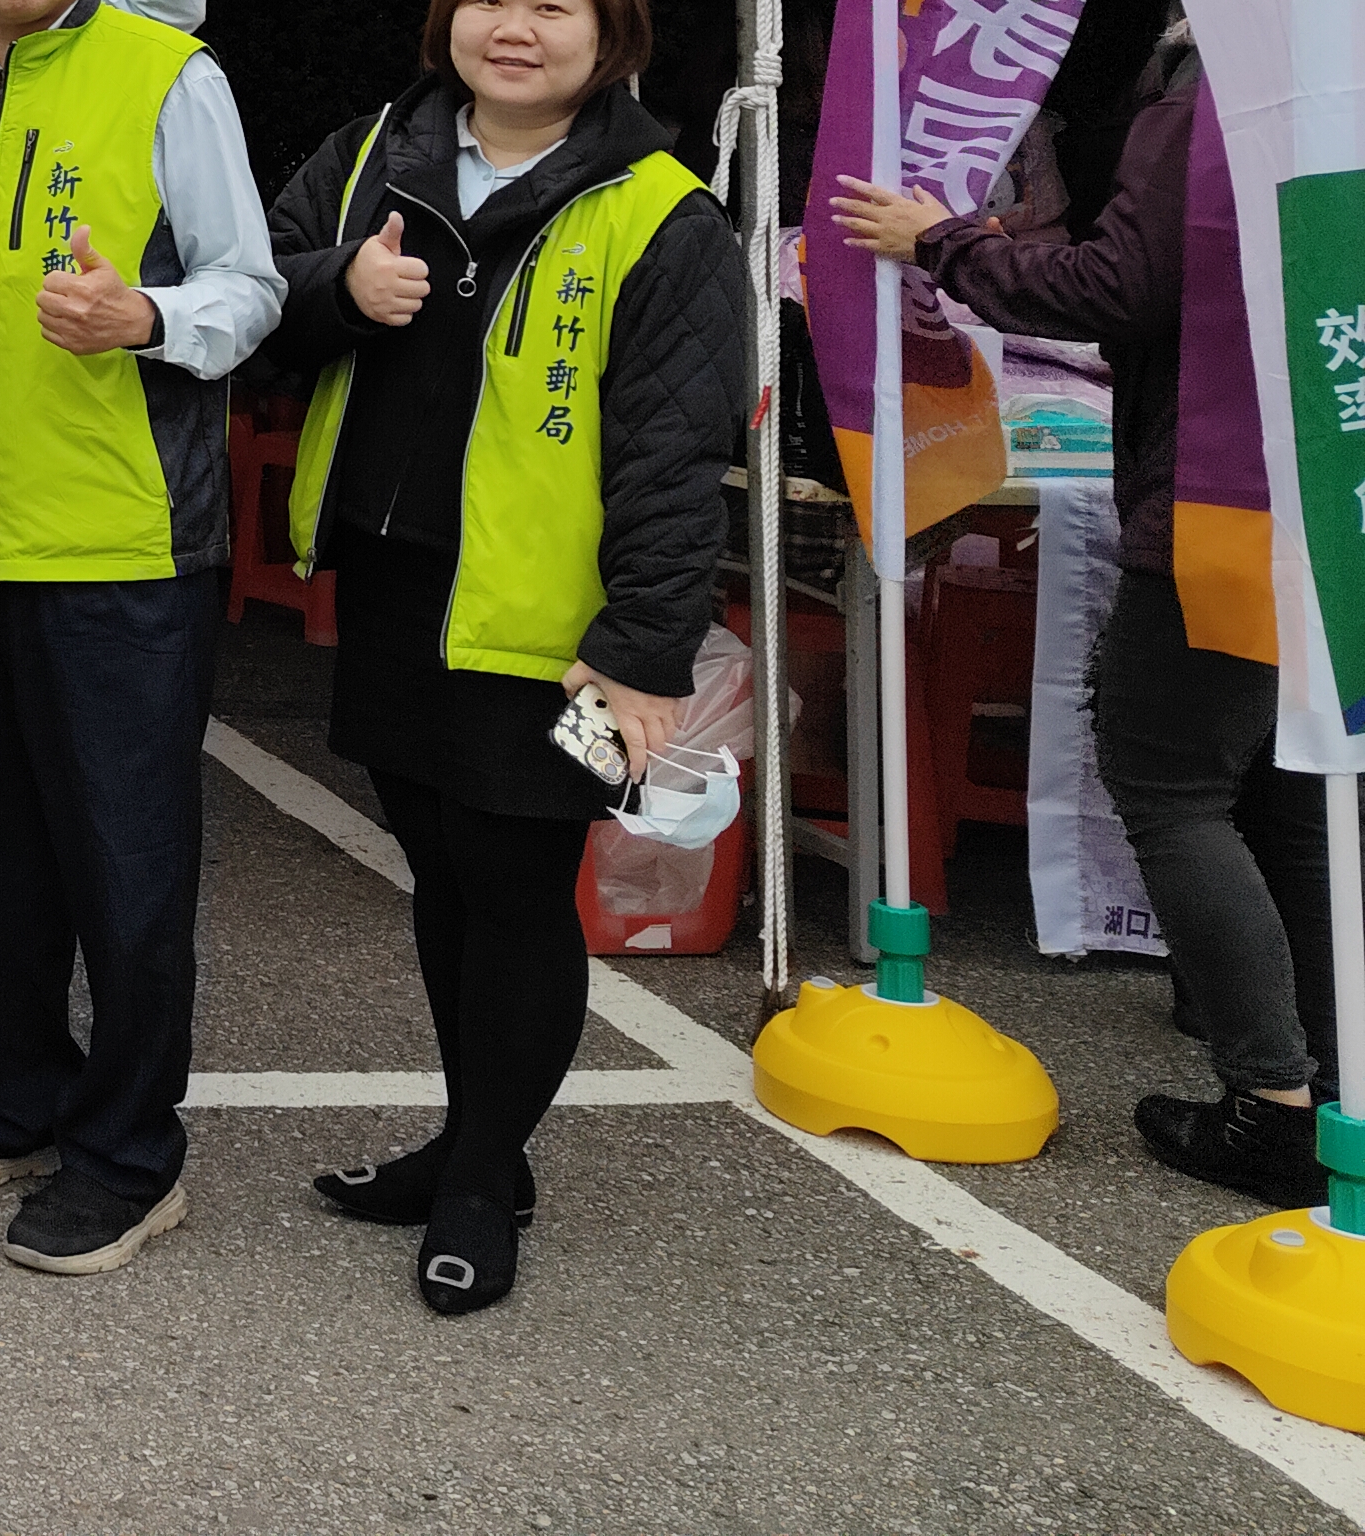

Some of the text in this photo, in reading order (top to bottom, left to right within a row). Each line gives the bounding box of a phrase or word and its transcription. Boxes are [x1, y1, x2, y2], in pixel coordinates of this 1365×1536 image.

[536, 269, 595, 446] 新竹郵局
[1104, 905, 1162, 939] 湖口
